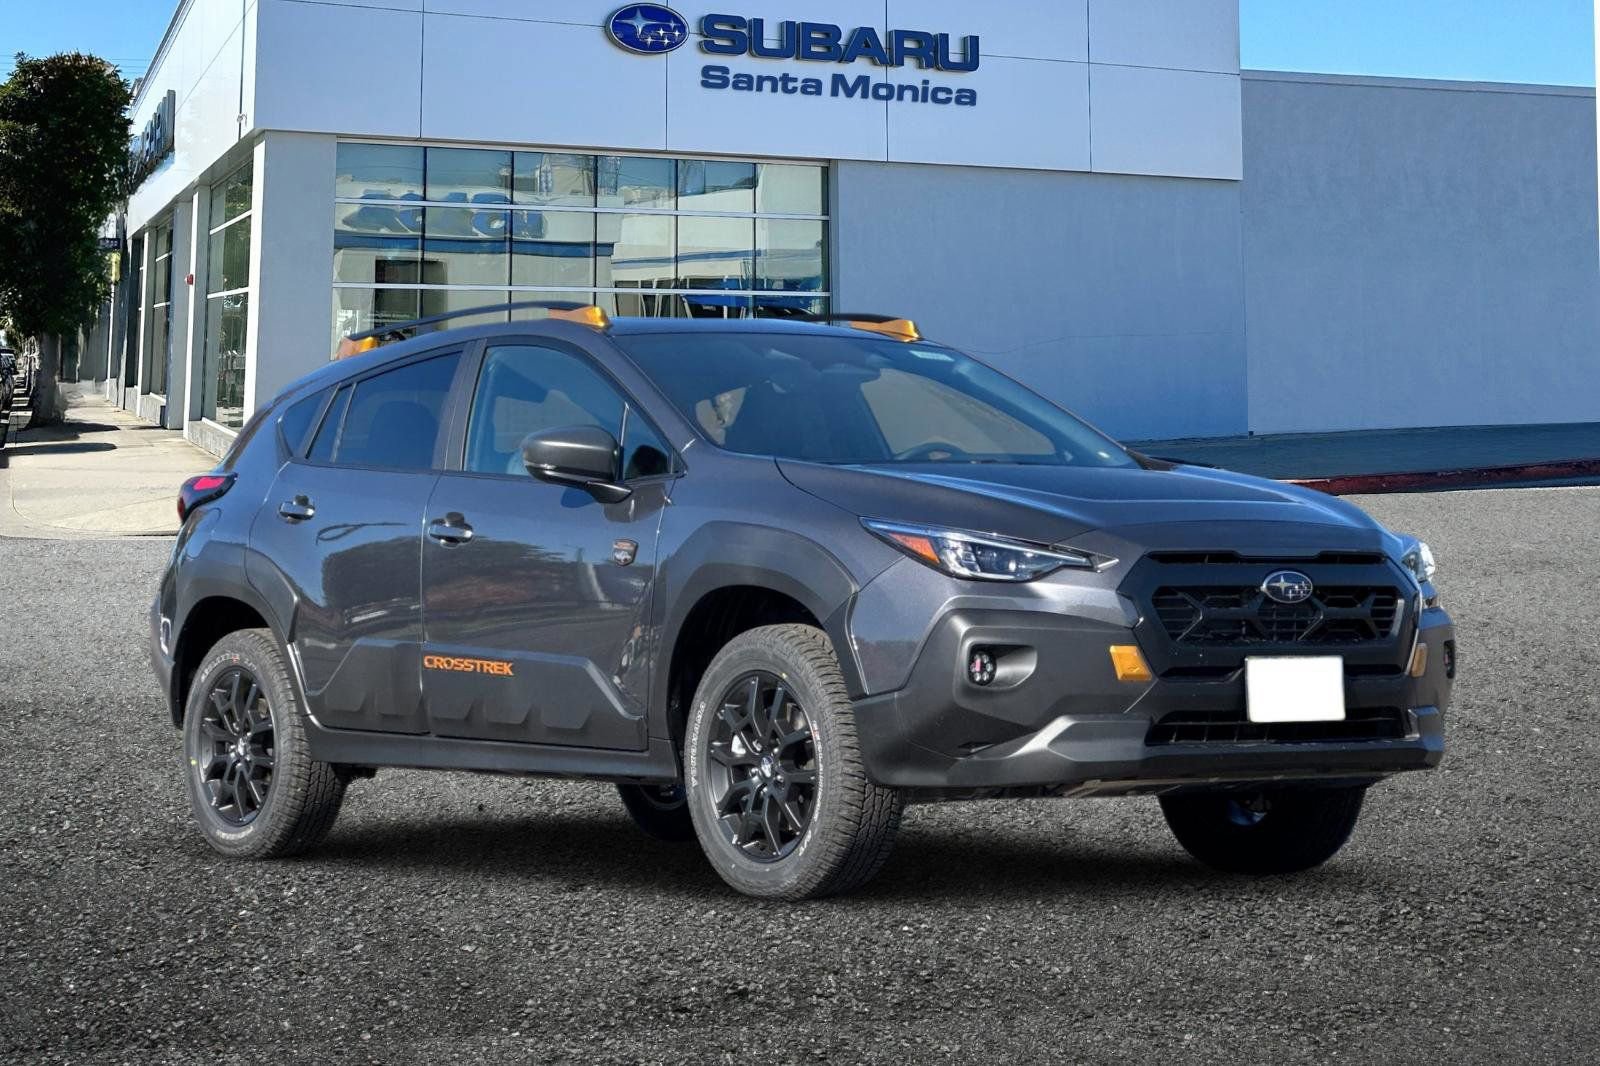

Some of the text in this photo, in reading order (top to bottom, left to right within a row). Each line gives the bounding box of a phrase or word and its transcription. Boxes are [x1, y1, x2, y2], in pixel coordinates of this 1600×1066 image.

[700, 13, 980, 72] SUBARU
[700, 64, 977, 106] Santa Monica
[423, 655, 514, 676] CROSSTREK
